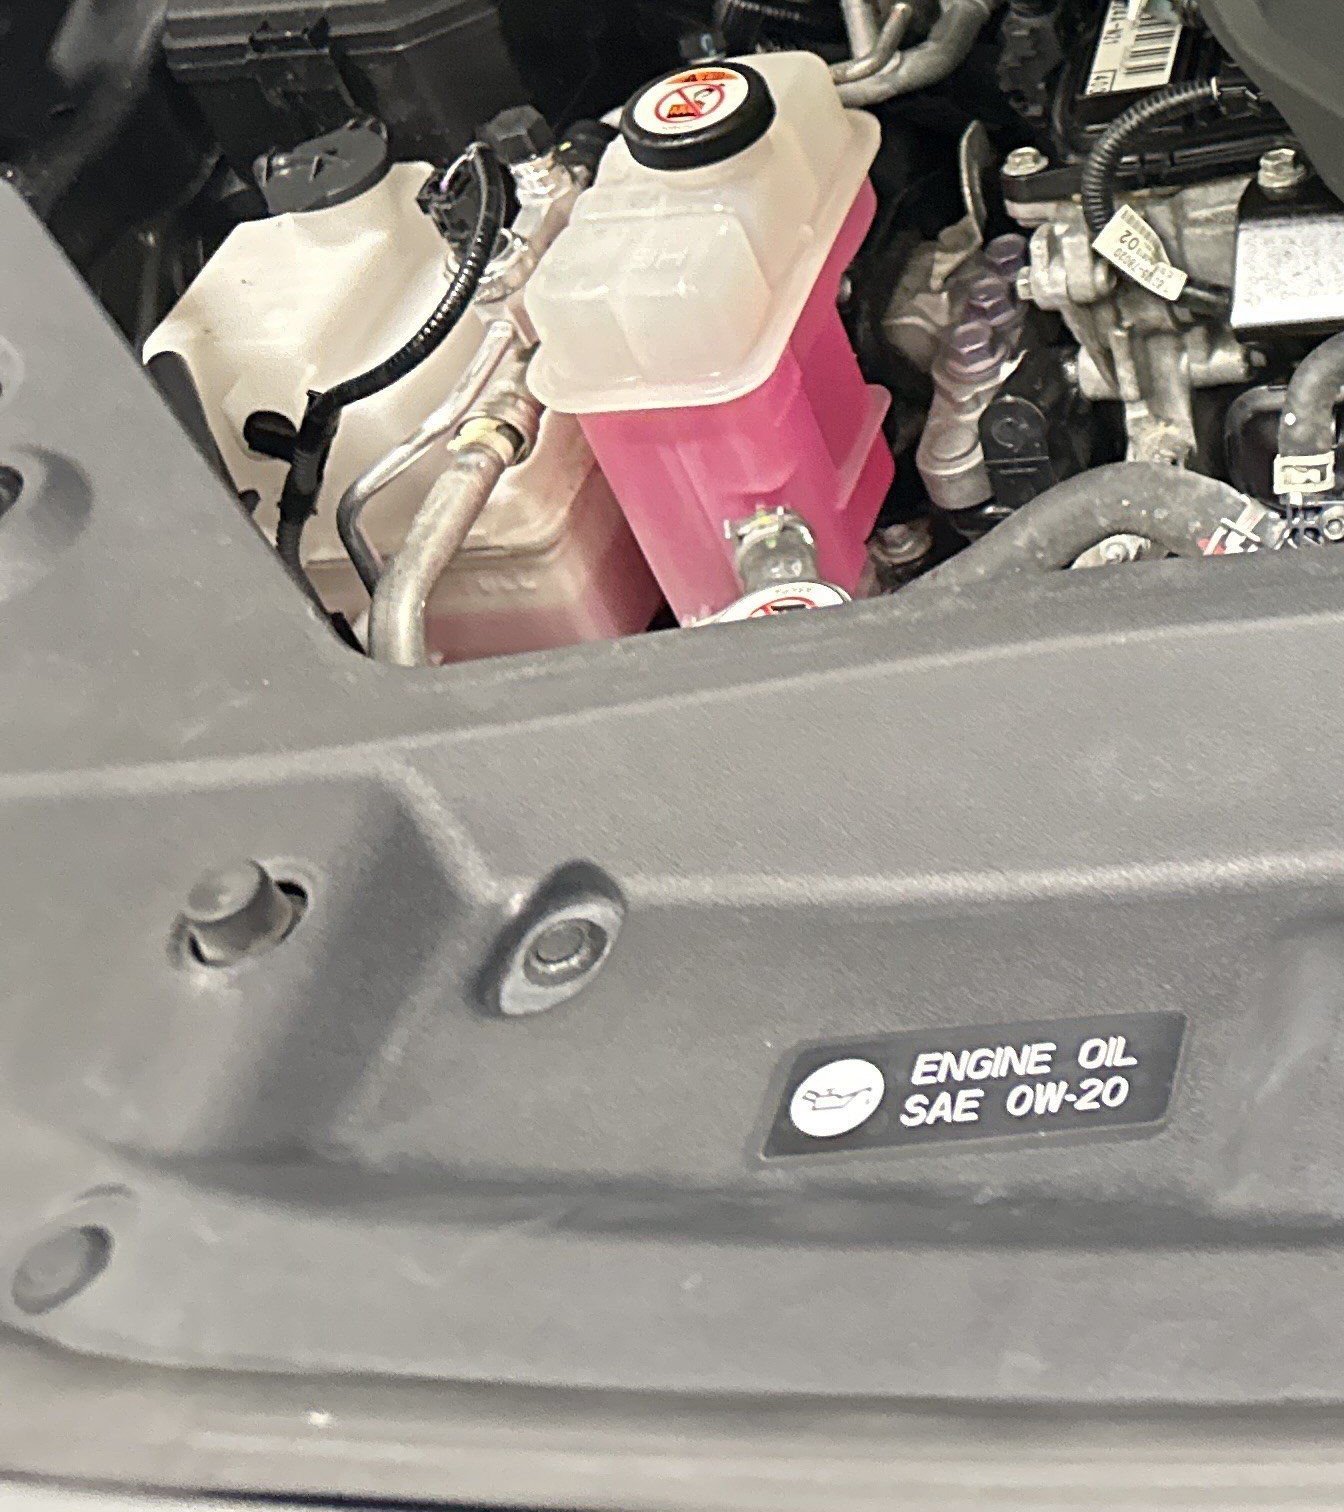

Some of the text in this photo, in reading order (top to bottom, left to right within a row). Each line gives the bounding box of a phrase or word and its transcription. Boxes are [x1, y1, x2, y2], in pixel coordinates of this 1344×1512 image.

[910, 1035, 1138, 1086] ENGINE OIL
[899, 1075, 1130, 1127] SAE 0W-20
